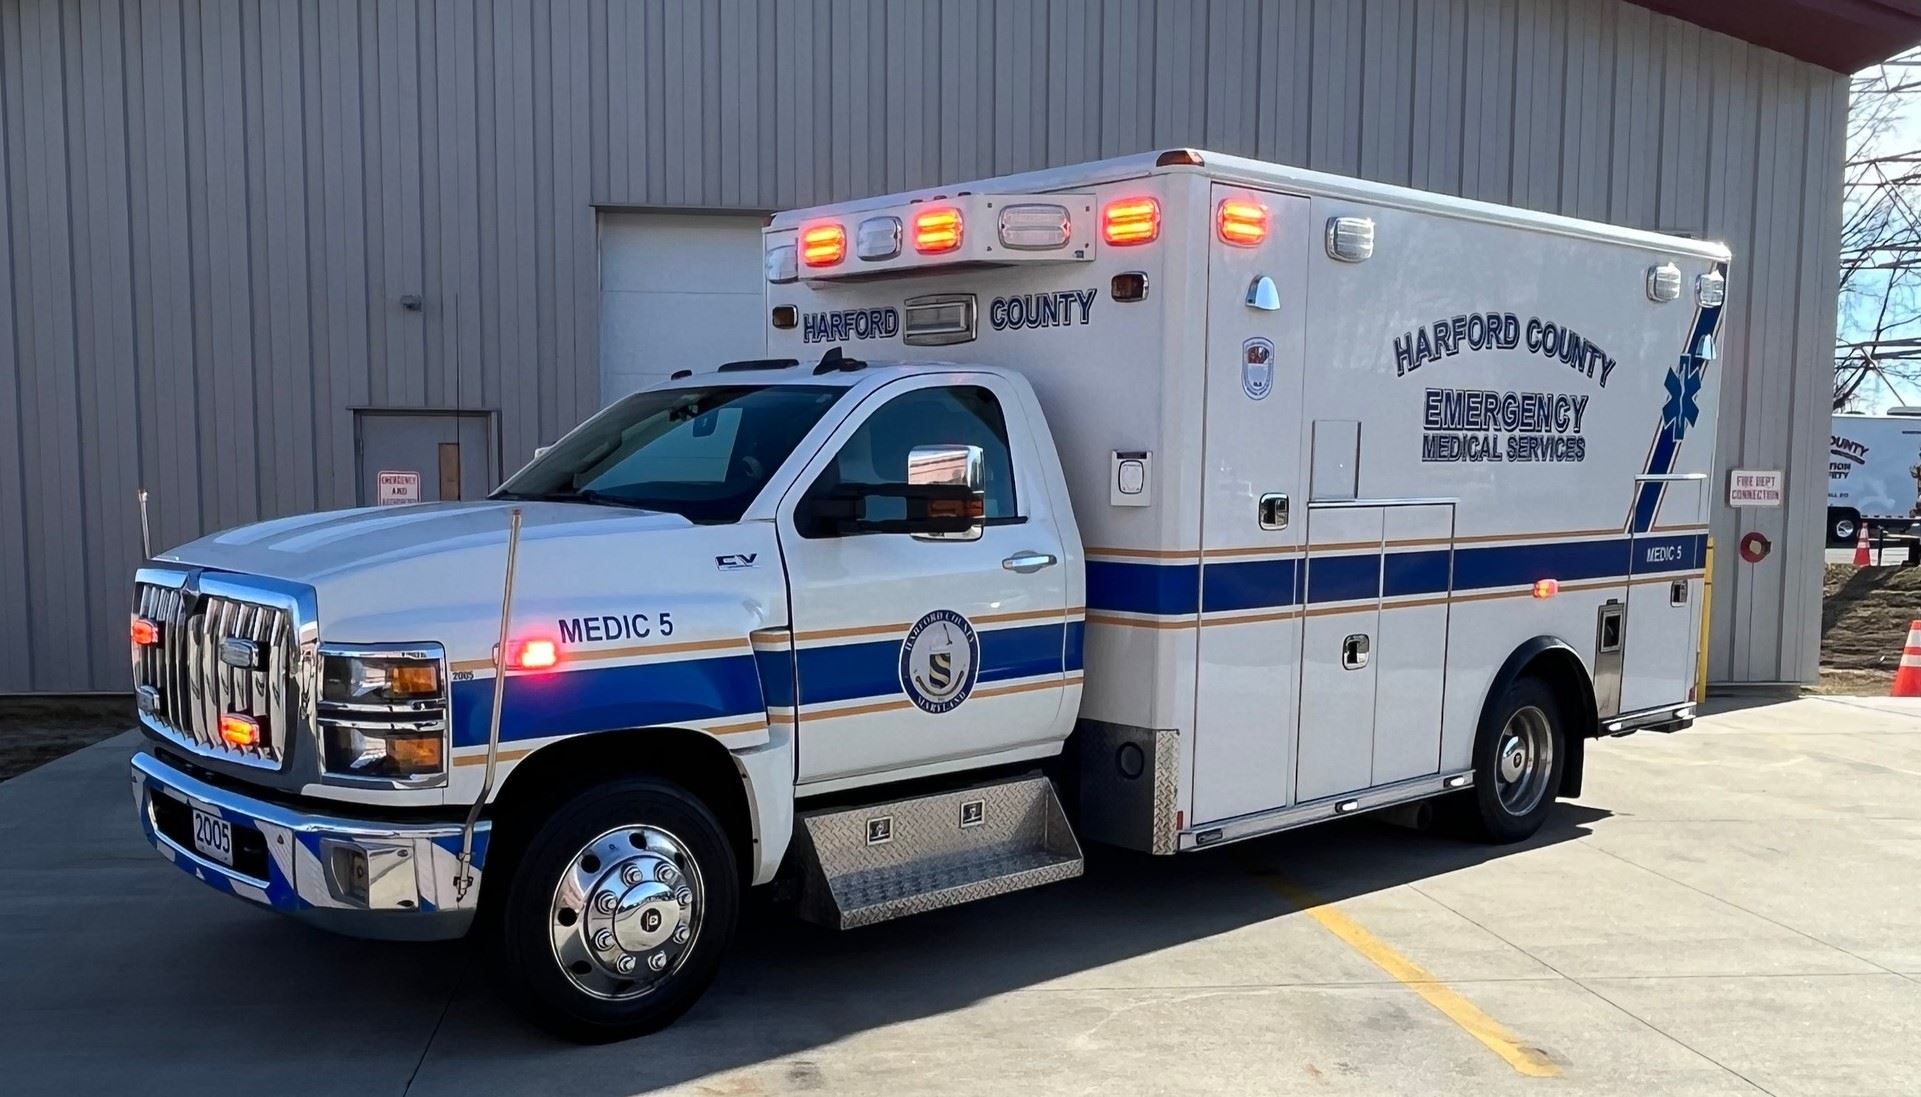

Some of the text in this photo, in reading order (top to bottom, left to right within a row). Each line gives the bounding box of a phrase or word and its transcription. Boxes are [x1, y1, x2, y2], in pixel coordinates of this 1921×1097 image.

[803, 288, 1097, 343] HARFORD COUNTY
[1393, 312, 1616, 388] HARFORD COUNTY
[1423, 388, 1589, 434] EMERGENCY
[1421, 433, 1586, 462] MEDICAL SERVICES
[392, 487, 408, 495] AND
[1736, 475, 1775, 487] FIRE DEPT
[1731, 489, 1779, 500] CONNECTION
[715, 553, 757, 567] CV
[1646, 545, 1682, 562] MEDIC 5
[558, 612, 674, 643] MEDIC 5
[904, 611, 975, 651] HARFORD COUNTY
[452, 671, 474, 681] 2005
[917, 691, 967, 713] MARYLAND
[195, 813, 230, 854] 2005
